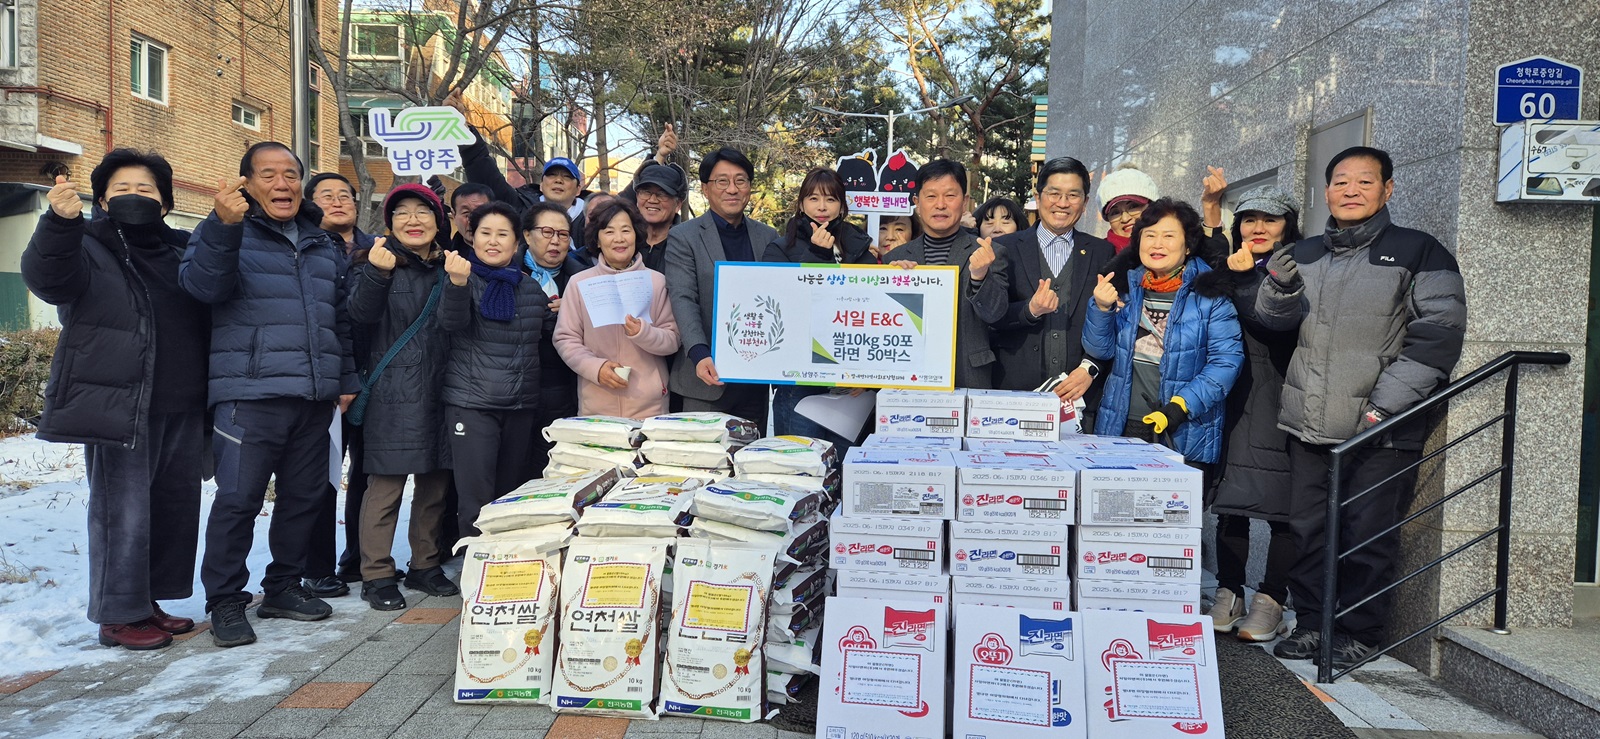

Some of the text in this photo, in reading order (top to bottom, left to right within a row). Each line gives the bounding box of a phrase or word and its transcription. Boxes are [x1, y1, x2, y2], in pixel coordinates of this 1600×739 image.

[1516, 67, 1563, 78] 청학로중앙길
[1520, 92, 1556, 118] 60
[393, 149, 456, 171] 남양주
[854, 195, 908, 208] 행복한 별내면
[798, 274, 943, 286] 나눔은 상상 더 이상의 행복입니다.
[832, 310, 904, 327] 서일 E&C
[739, 338, 767, 346] 기부천사
[832, 332, 913, 349] 쌀10kg 50포
[834, 347, 912, 363] 라면 50박스
[890, 414, 912, 424] 진라면
[981, 416, 1004, 426] 진라면
[976, 494, 1005, 507] 진라면
[848, 542, 876, 555] 진라면
[969, 549, 998, 562] 진라면
[1098, 551, 1127, 565] 진라면
[471, 603, 540, 626] 연천쌀
[570, 610, 641, 633] 연천쌀
[892, 620, 927, 636] 진라면
[1028, 629, 1064, 644] 진라면
[1157, 634, 1195, 649] 진라면
[981, 650, 1006, 662] 오뚜기
